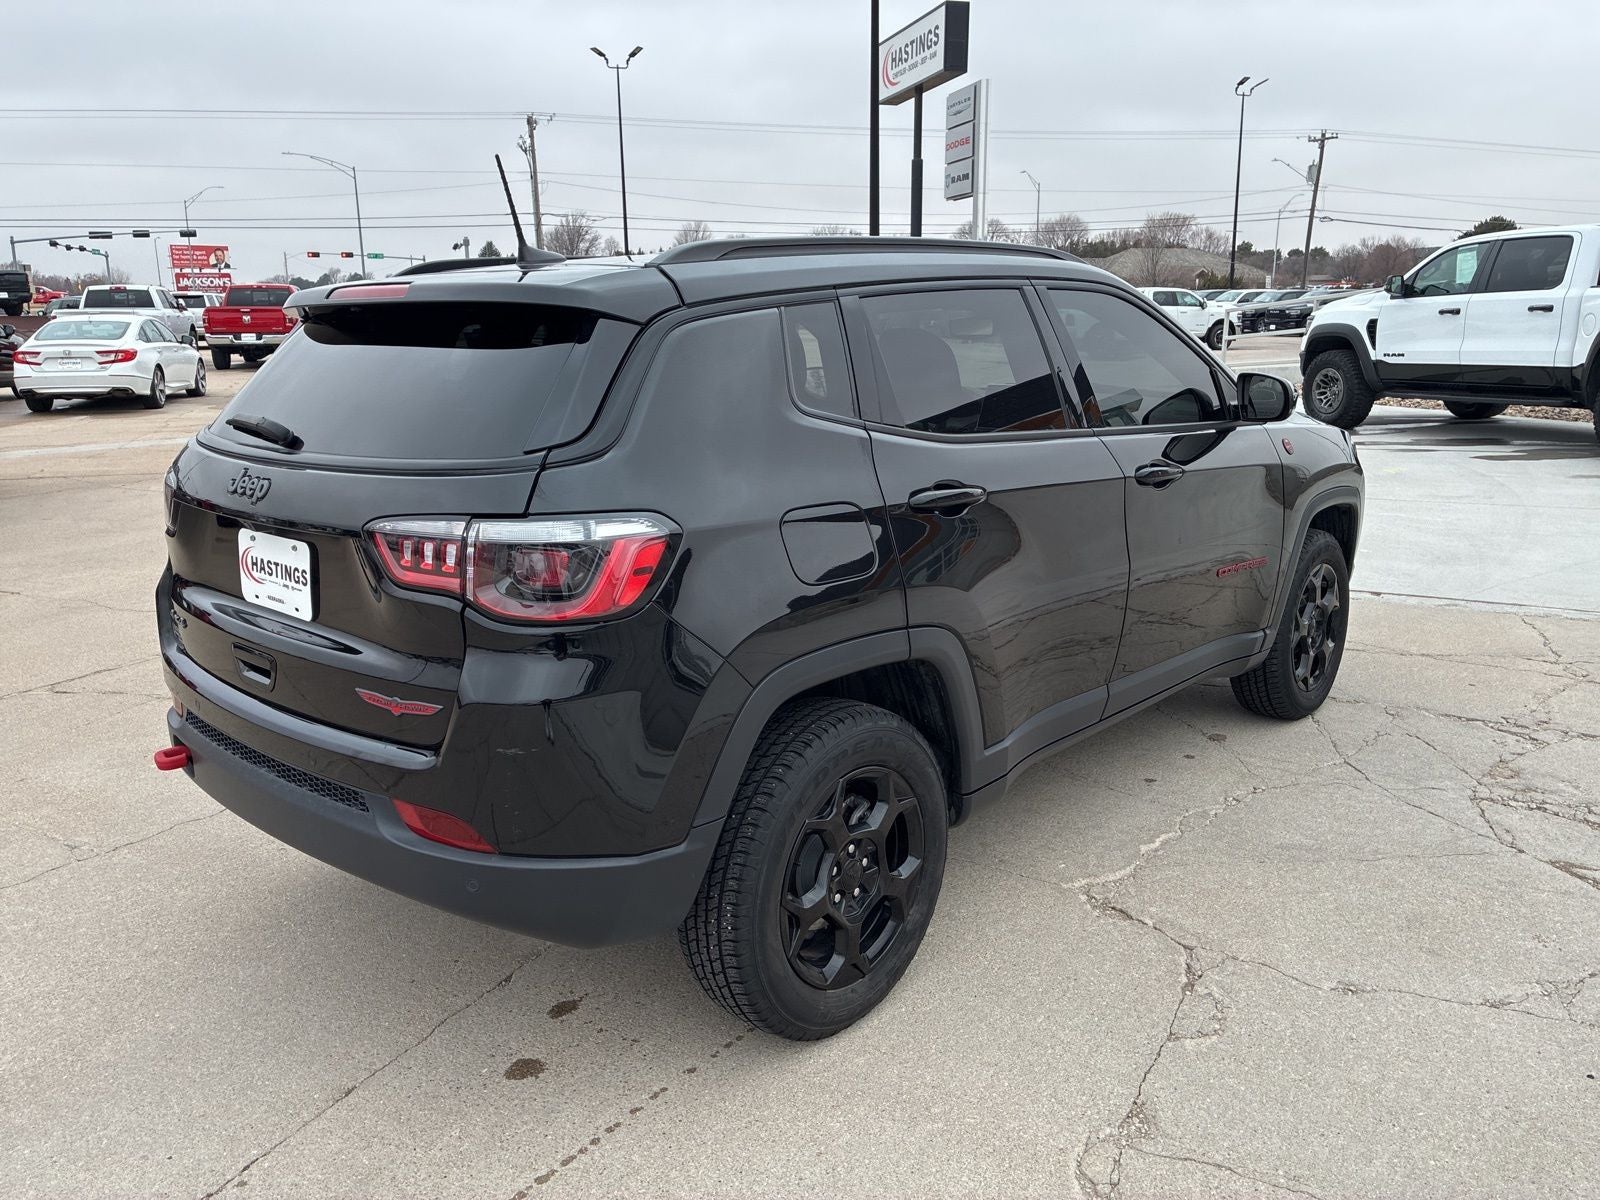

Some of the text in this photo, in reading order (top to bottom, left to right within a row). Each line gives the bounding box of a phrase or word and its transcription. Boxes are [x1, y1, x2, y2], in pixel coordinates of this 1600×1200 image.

[890, 24, 940, 71] HASTINGS
[947, 96, 971, 110] CHRYSLER
[945, 136, 971, 151] DODGE
[951, 172, 970, 184] RAM
[177, 277, 231, 288] JACKSON'S
[226, 467, 272, 506] Jeep
[250, 555, 308, 587] HASTINGS
